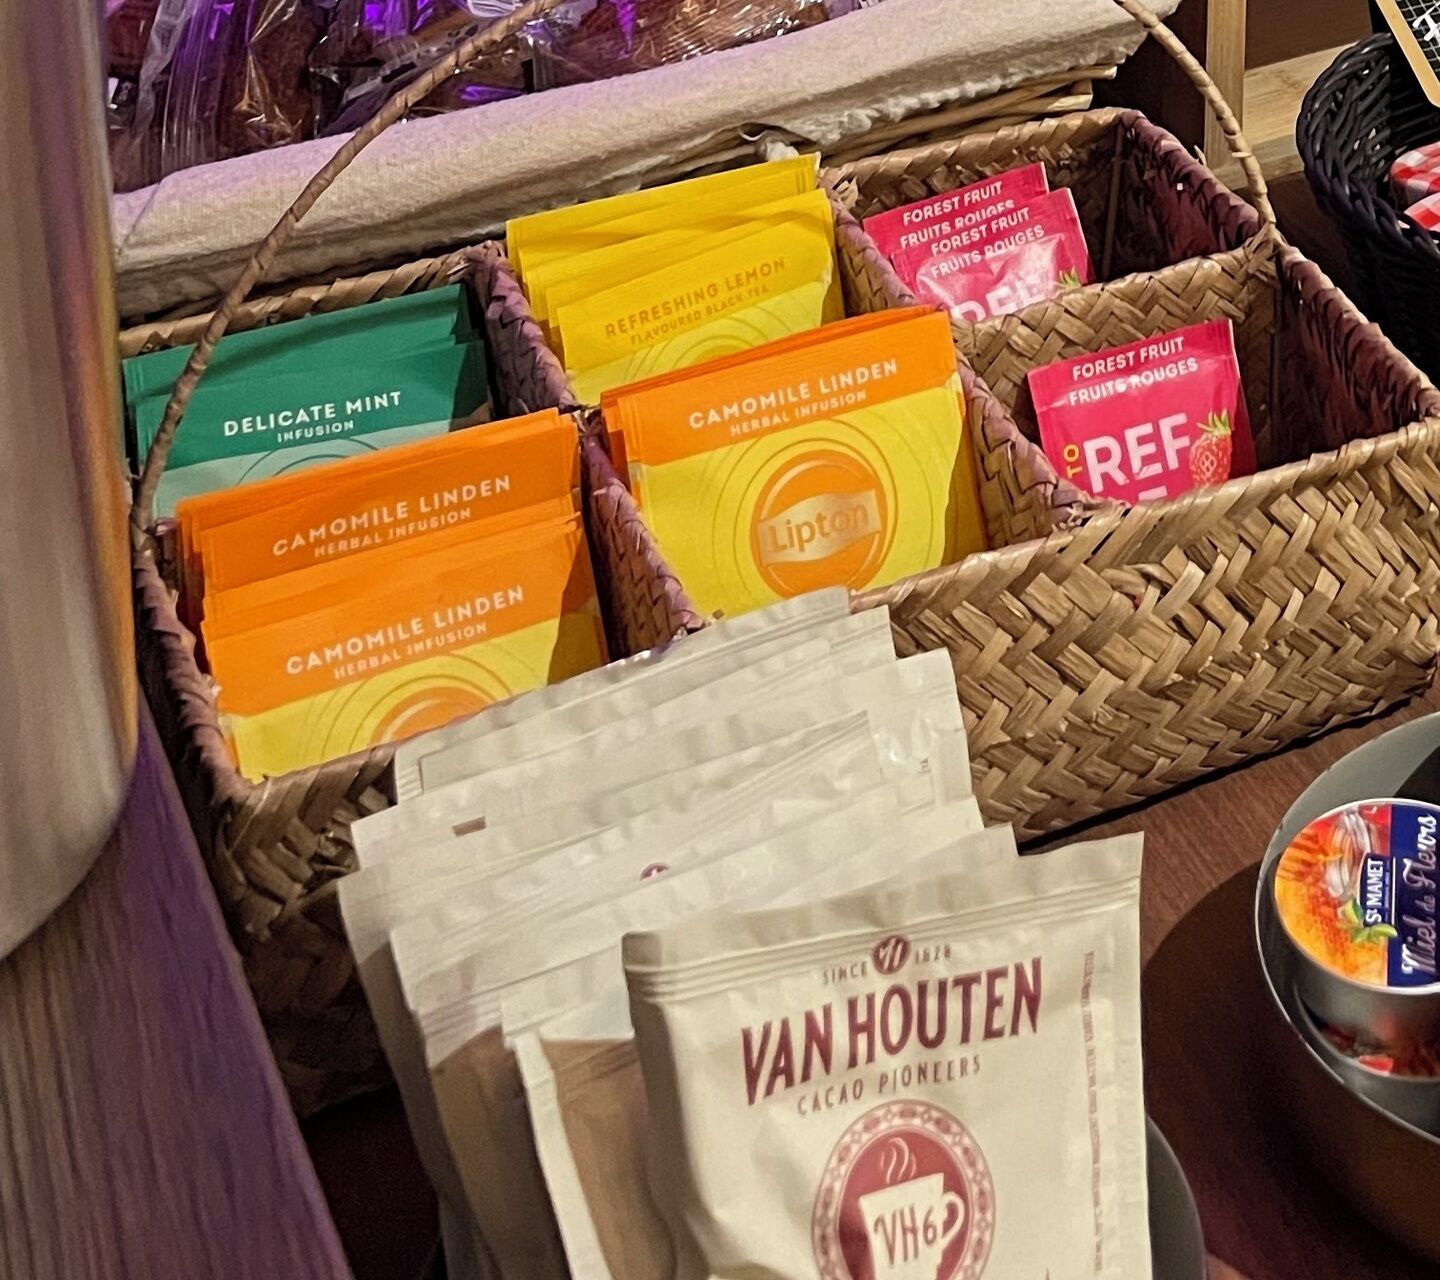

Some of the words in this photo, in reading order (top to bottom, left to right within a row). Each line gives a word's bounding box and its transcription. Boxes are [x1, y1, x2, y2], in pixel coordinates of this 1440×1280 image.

[902, 196, 961, 227] FOREST
[963, 180, 1003, 206] FRUIT
[899, 222, 952, 250] FRUITS
[929, 224, 988, 258] FOREST
[990, 206, 1030, 233] FRUIT
[929, 249, 983, 279] FRUITS
[984, 224, 1045, 259] ROUGES
[604, 282, 720, 339] REFRESHING
[725, 257, 786, 292] LEMON
[629, 310, 701, 346] FLAVOURED
[705, 293, 744, 317] BLACK
[747, 284, 770, 299] TEA
[1068, 377, 1128, 407] FRUITS
[1128, 356, 1199, 389] ROUGES
[1072, 350, 1136, 382] FOREST
[1139, 335, 1185, 363] FRUIT
[223, 402, 337, 438] DELICATE
[344, 390, 402, 414] MINT
[688, 382, 811, 430] CAMOMILE
[818, 358, 898, 396] LINDEN
[729, 411, 791, 437] HERBAL
[794, 389, 868, 420] INFUSION
[276, 419, 355, 444] INFUSION
[1083, 411, 1191, 494] REF
[1062, 443, 1083, 479] TO
[271, 500, 410, 557] CAMOMILE
[419, 474, 512, 514] LINDEN
[313, 531, 384, 559] HERBAL
[388, 507, 472, 541] INFUSION
[768, 502, 870, 554] Lipton
[285, 617, 425, 676] CAMOMILE
[433, 584, 525, 629] LINDEN
[333, 649, 402, 681] HERBAL
[406, 621, 488, 657] INFUSION
[1402, 813, 1438, 890] Fleurs
[1366, 856, 1385, 908] MAMET
[1414, 893, 1436, 912] de
[1401, 915, 1437, 975] Miel
[822, 960, 868, 986] SINCE
[740, 1001, 834, 1108] VAN
[845, 955, 1043, 1071] HOUTEN
[796, 1077, 865, 1119] CACAO
[877, 1053, 982, 1095] PIONEERS
